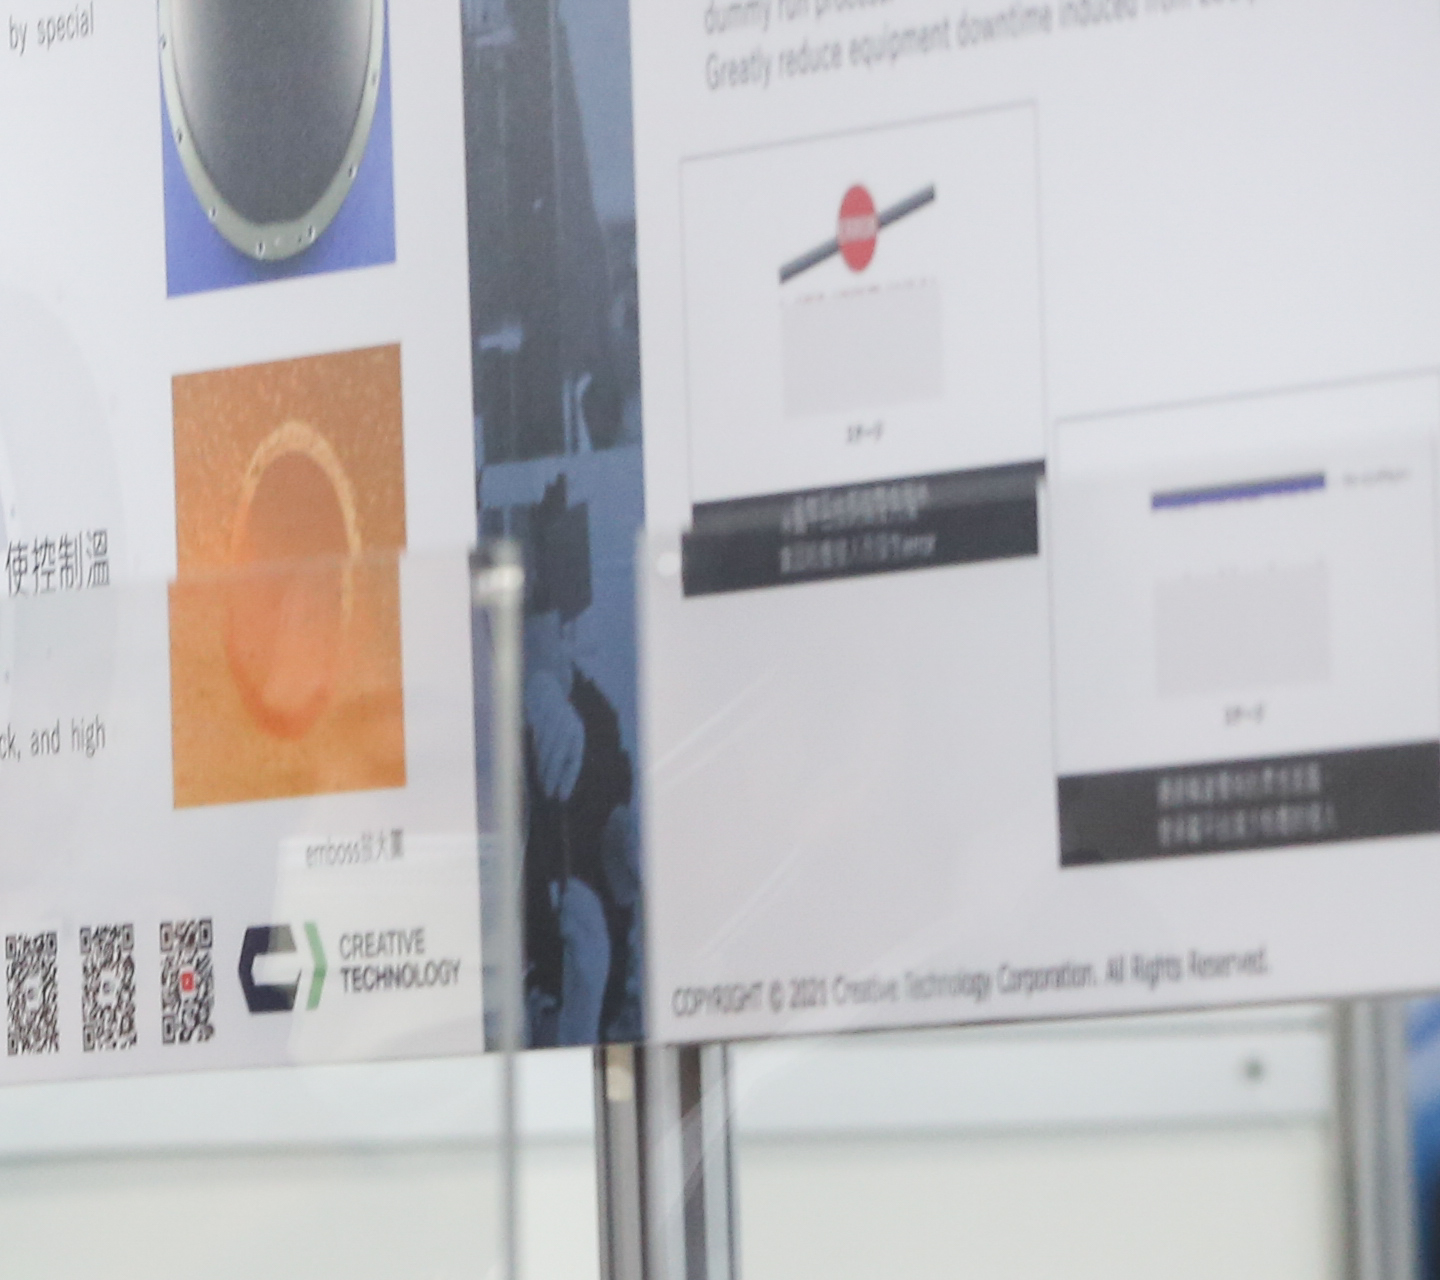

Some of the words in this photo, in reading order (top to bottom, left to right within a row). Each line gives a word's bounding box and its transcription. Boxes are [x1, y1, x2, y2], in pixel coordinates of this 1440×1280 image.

[9, 14, 28, 58] by
[37, 1, 94, 52] special
[705, 48, 773, 91] Greatly
[778, 38, 844, 80] reduce
[848, 18, 950, 71] equipment
[957, 6, 1053, 49] downtime
[30, 718, 61, 757] and
[71, 713, 107, 759] high
[339, 926, 425, 961] CREATIVE
[340, 958, 462, 995] TECHNOLOGY
[672, 980, 764, 1017] COPYRIGHT
[832, 971, 900, 1004] Creative
[904, 966, 992, 1003] Technology
[996, 960, 1096, 998] Corporation.
[1105, 954, 1124, 985] All
[1131, 951, 1184, 991] Rights
[1189, 944, 1272, 980] Reserved.
